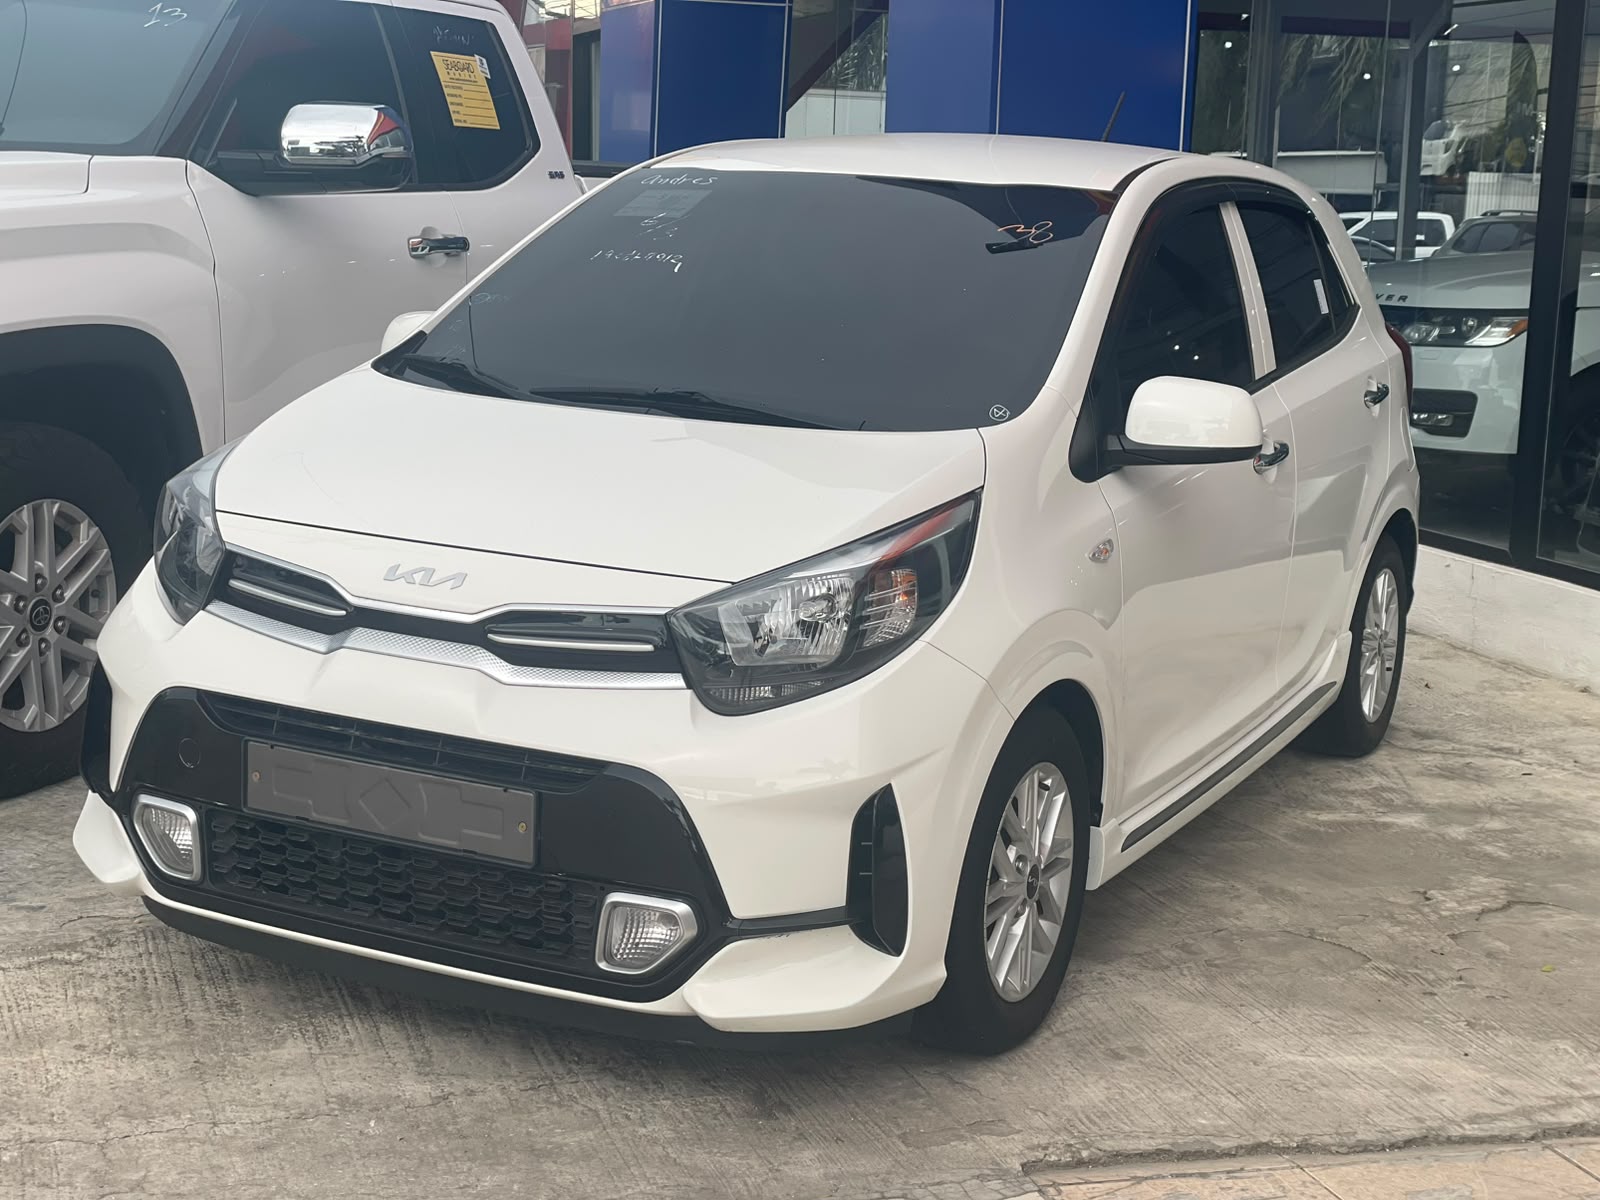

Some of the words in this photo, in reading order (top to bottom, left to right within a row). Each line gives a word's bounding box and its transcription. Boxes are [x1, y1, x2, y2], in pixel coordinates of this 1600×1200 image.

[143, 2, 187, 28] 13
[442, 59, 475, 74] SEABOARD
[992, 220, 1054, 249] 38
[1375, 293, 1408, 303] VER
